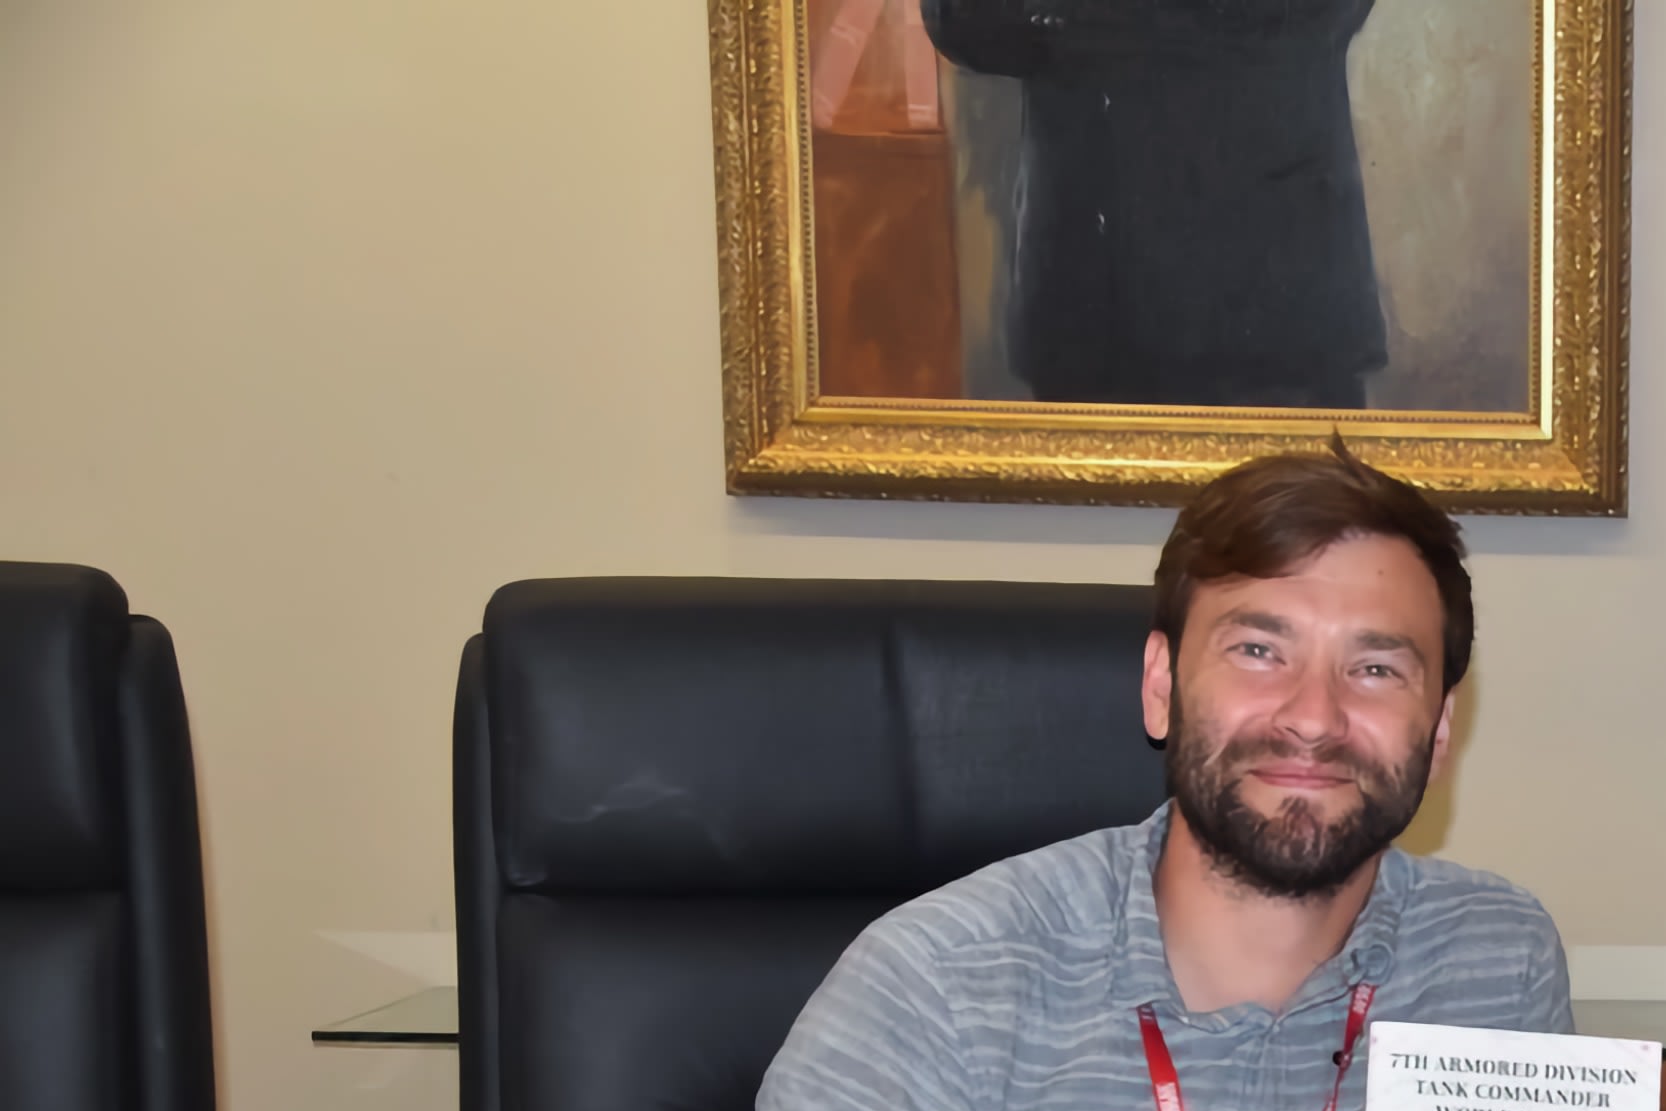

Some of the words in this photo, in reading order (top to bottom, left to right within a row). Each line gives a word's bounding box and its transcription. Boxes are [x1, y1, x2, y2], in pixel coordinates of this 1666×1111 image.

[1390, 1052, 1428, 1072] 7TH
[1434, 1055, 1539, 1079] ARMORED
[1544, 1064, 1638, 1085] DIVISION
[1416, 1079, 1468, 1099] TANK
[1474, 1083, 1611, 1109] COMMANDER
